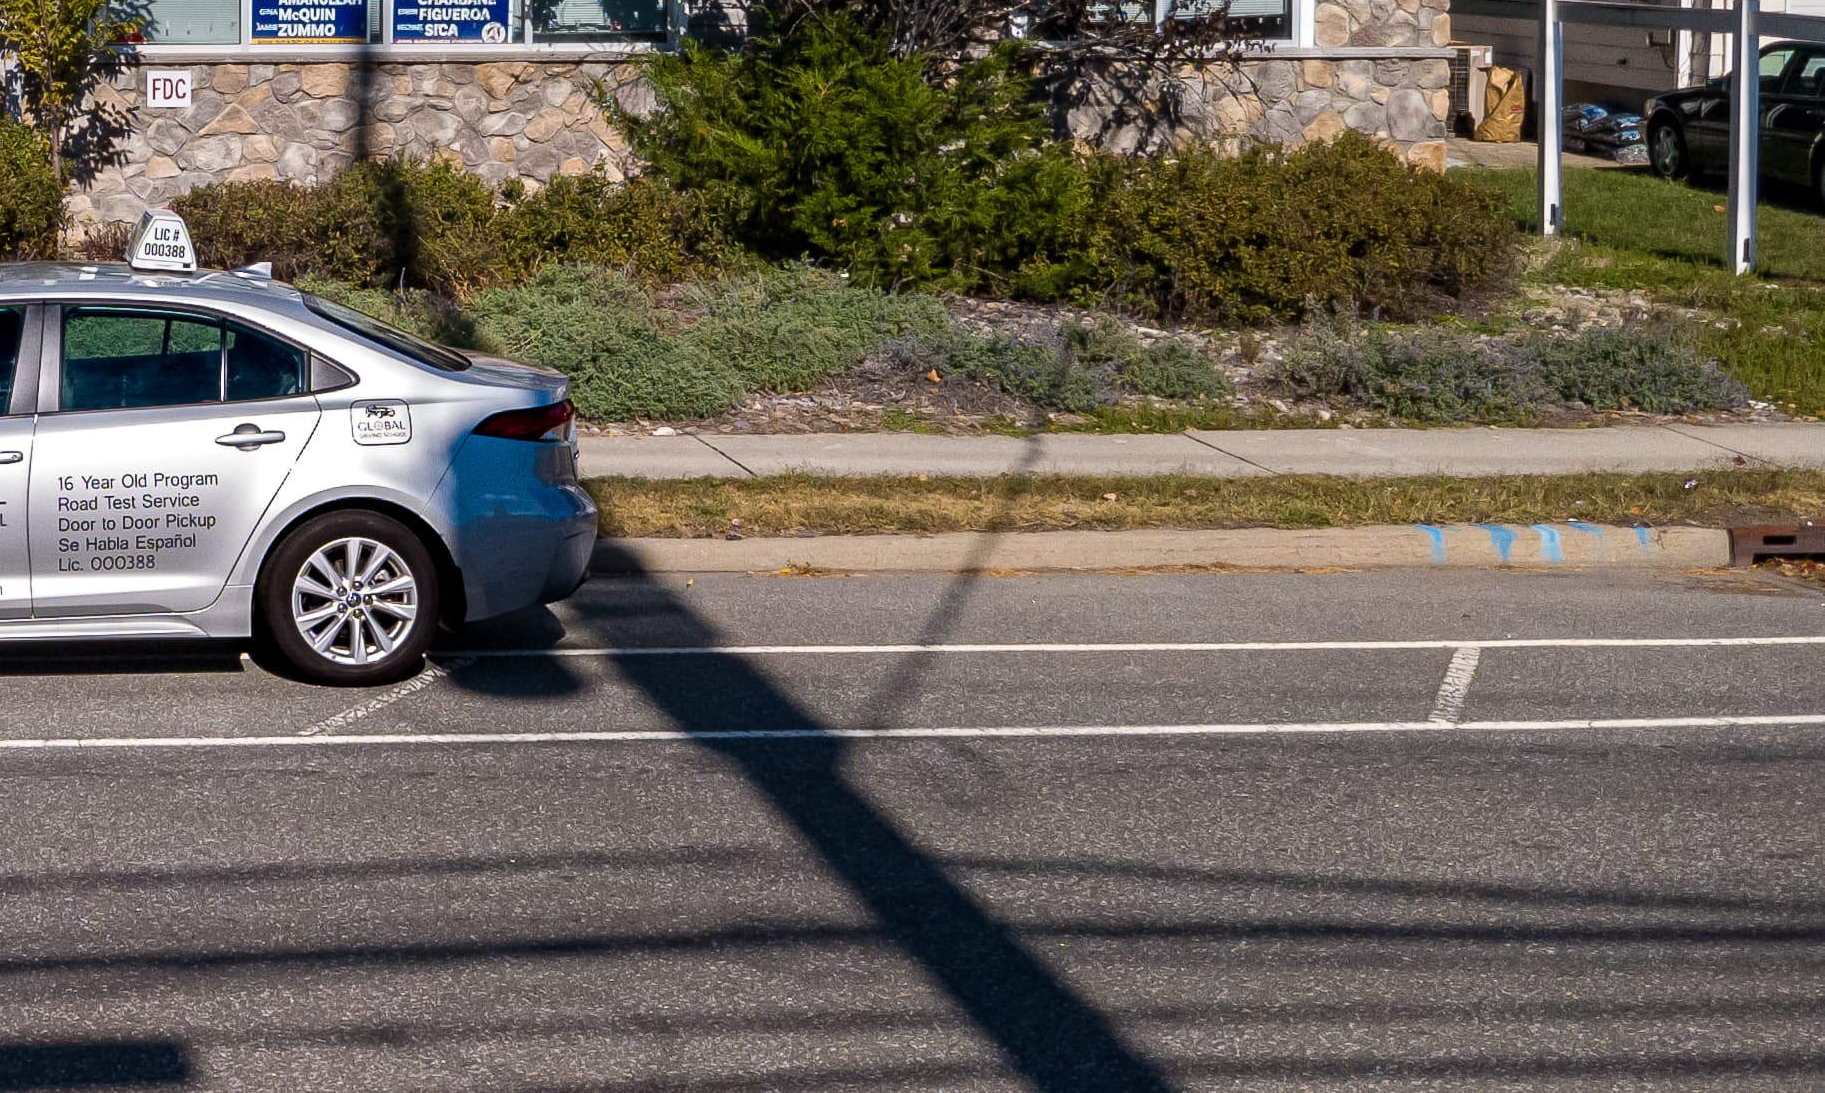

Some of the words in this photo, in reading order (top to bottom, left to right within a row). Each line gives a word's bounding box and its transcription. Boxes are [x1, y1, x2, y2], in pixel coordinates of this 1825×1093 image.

[278, 8, 336, 22] McQUIN
[418, 8, 491, 21] FIGUEROA
[277, 23, 336, 37] ZUMMO
[424, 23, 459, 37] SICA
[152, 78, 187, 100] FDC
[154, 227, 171, 241] LIC
[173, 228, 180, 242] #
[144, 243, 186, 258] 000388
[58, 476, 74, 491] 16
[82, 475, 115, 490] Year
[121, 473, 147, 488] Old
[154, 473, 218, 490] Program
[58, 496, 98, 512] Road
[104, 495, 136, 510] Test
[142, 493, 200, 509] Service
[58, 518, 96, 532] Door
[102, 517, 116, 531] to
[123, 515, 160, 530] Door
[166, 513, 216, 530] Pickup
[58, 538, 79, 552] Se
[86, 536, 129, 551] Habla
[135, 533, 196, 552] Español
[58, 558, 83, 571] Lic.
[91, 555, 156, 571] 000388
